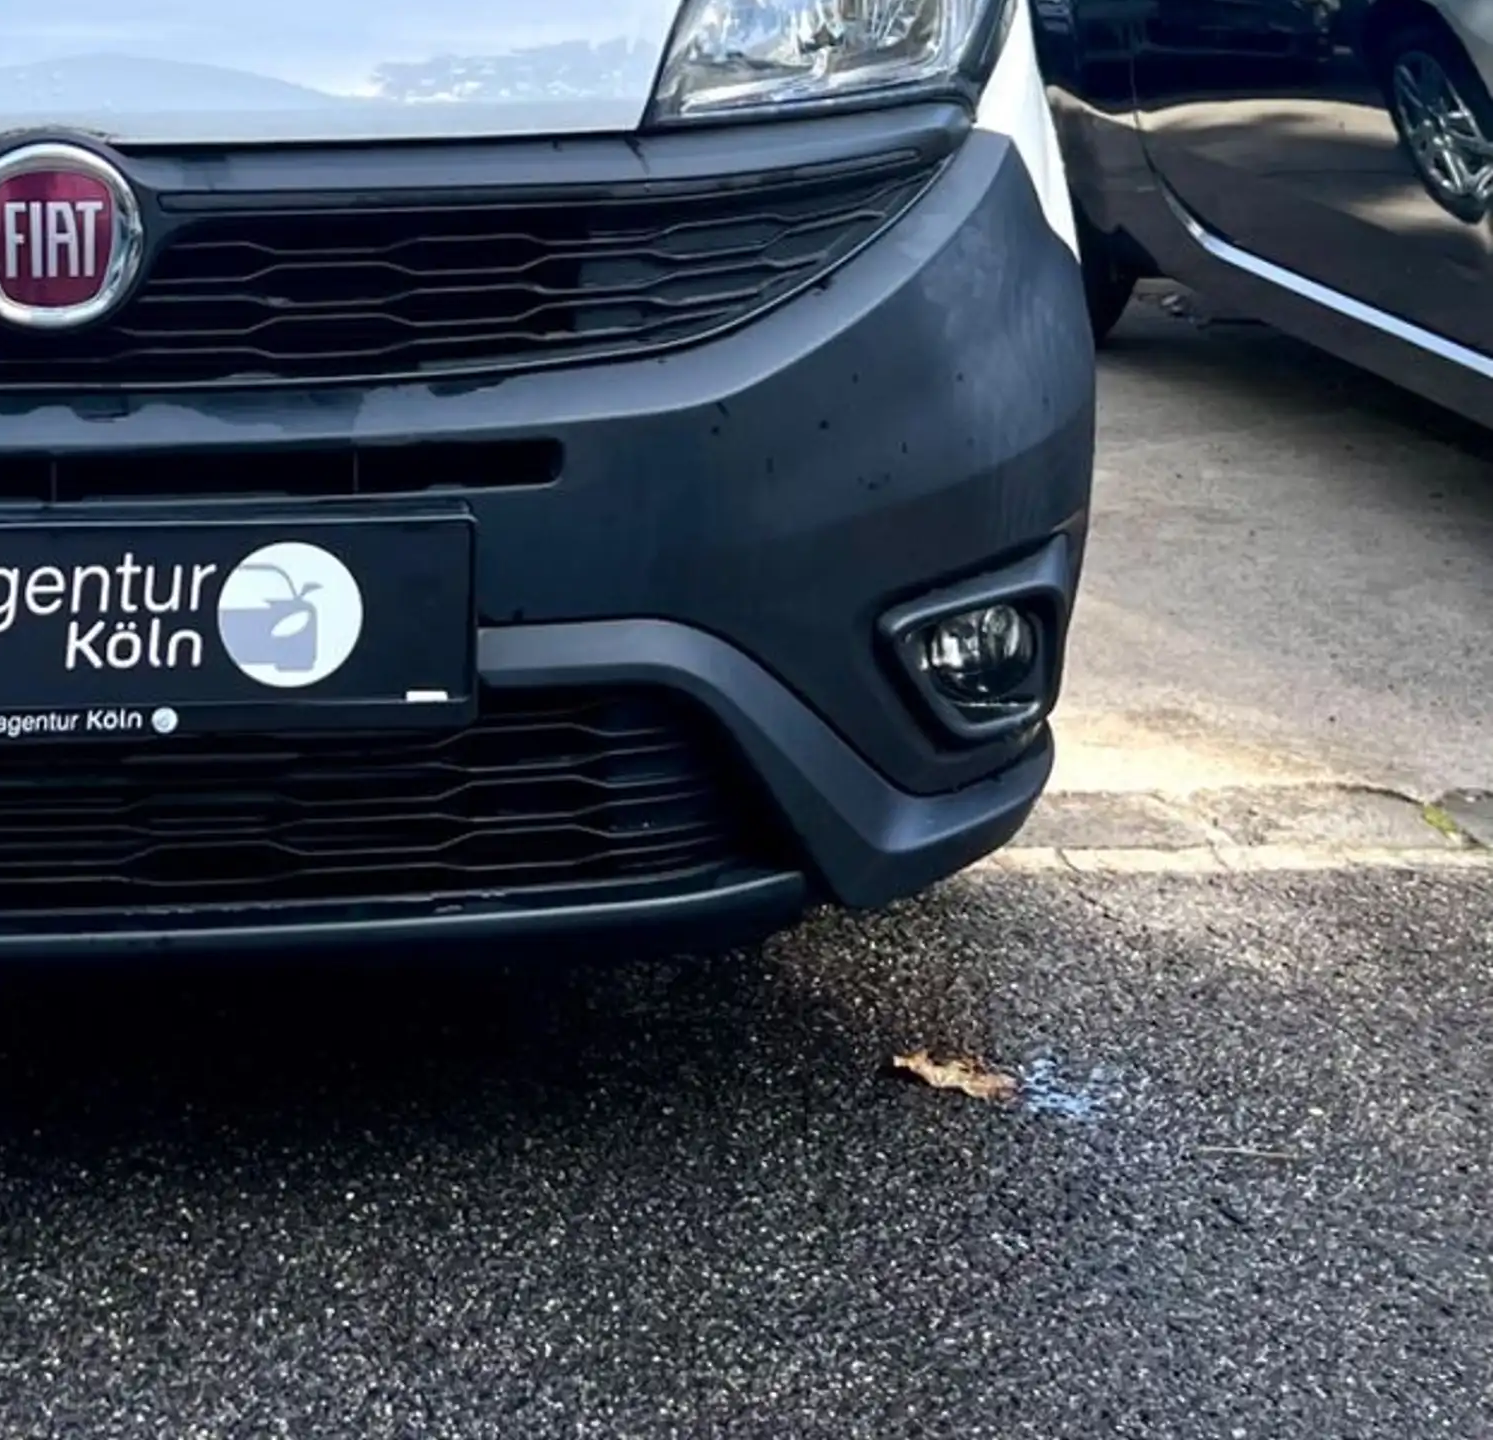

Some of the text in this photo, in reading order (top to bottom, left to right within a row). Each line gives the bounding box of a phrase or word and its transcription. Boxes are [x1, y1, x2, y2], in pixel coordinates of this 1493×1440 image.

[3, 200, 104, 279] FIAT
[64, 617, 203, 670] Köln
[85, 709, 143, 731] Köln
